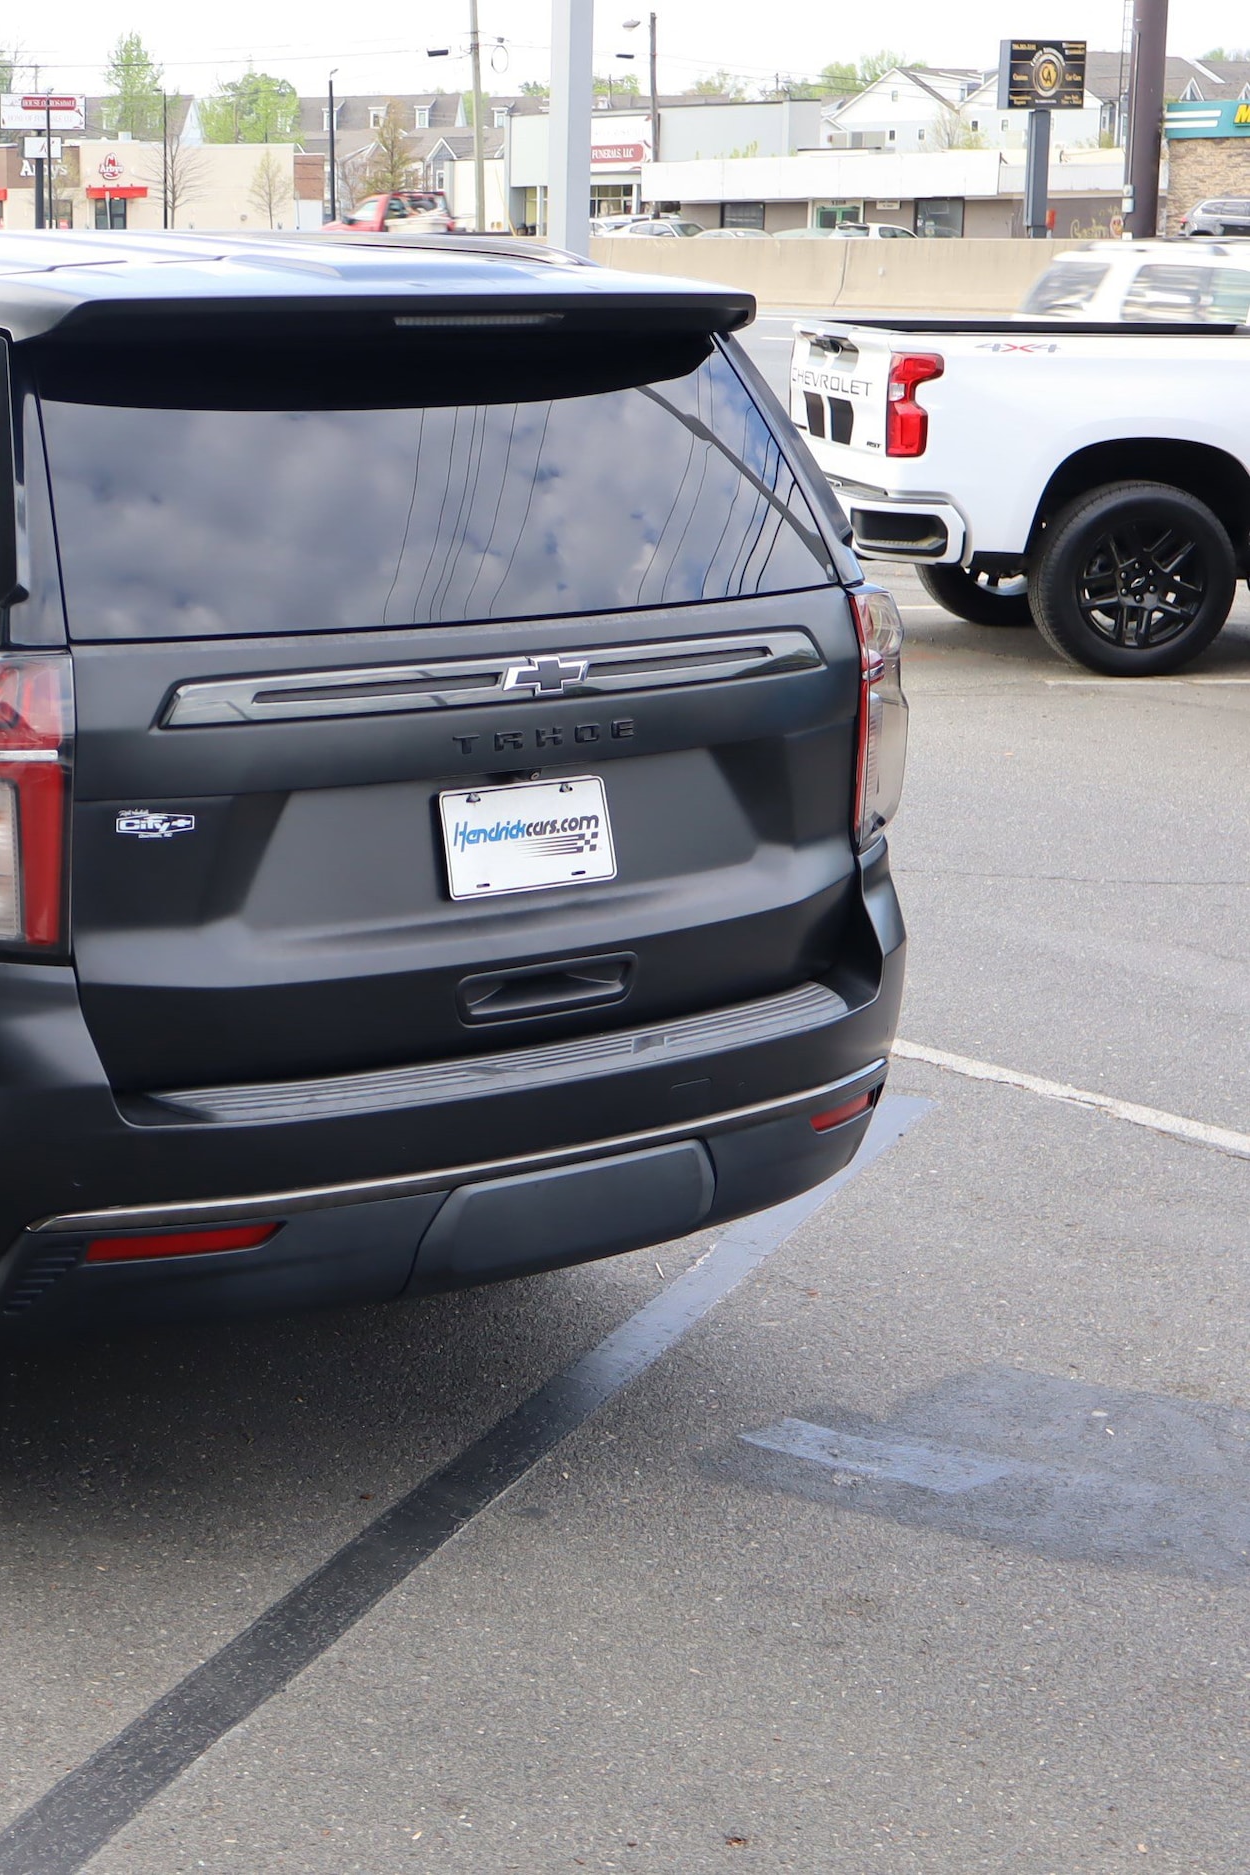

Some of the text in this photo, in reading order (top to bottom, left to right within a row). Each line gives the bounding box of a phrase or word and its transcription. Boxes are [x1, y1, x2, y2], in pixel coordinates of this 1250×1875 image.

[974, 342, 1062, 354] 4X4
[792, 366, 874, 397] CHEVROLET
[452, 719, 635, 755] TAHOE
[119, 818, 170, 833] City
[453, 814, 600, 853] Hendrickcars.com
